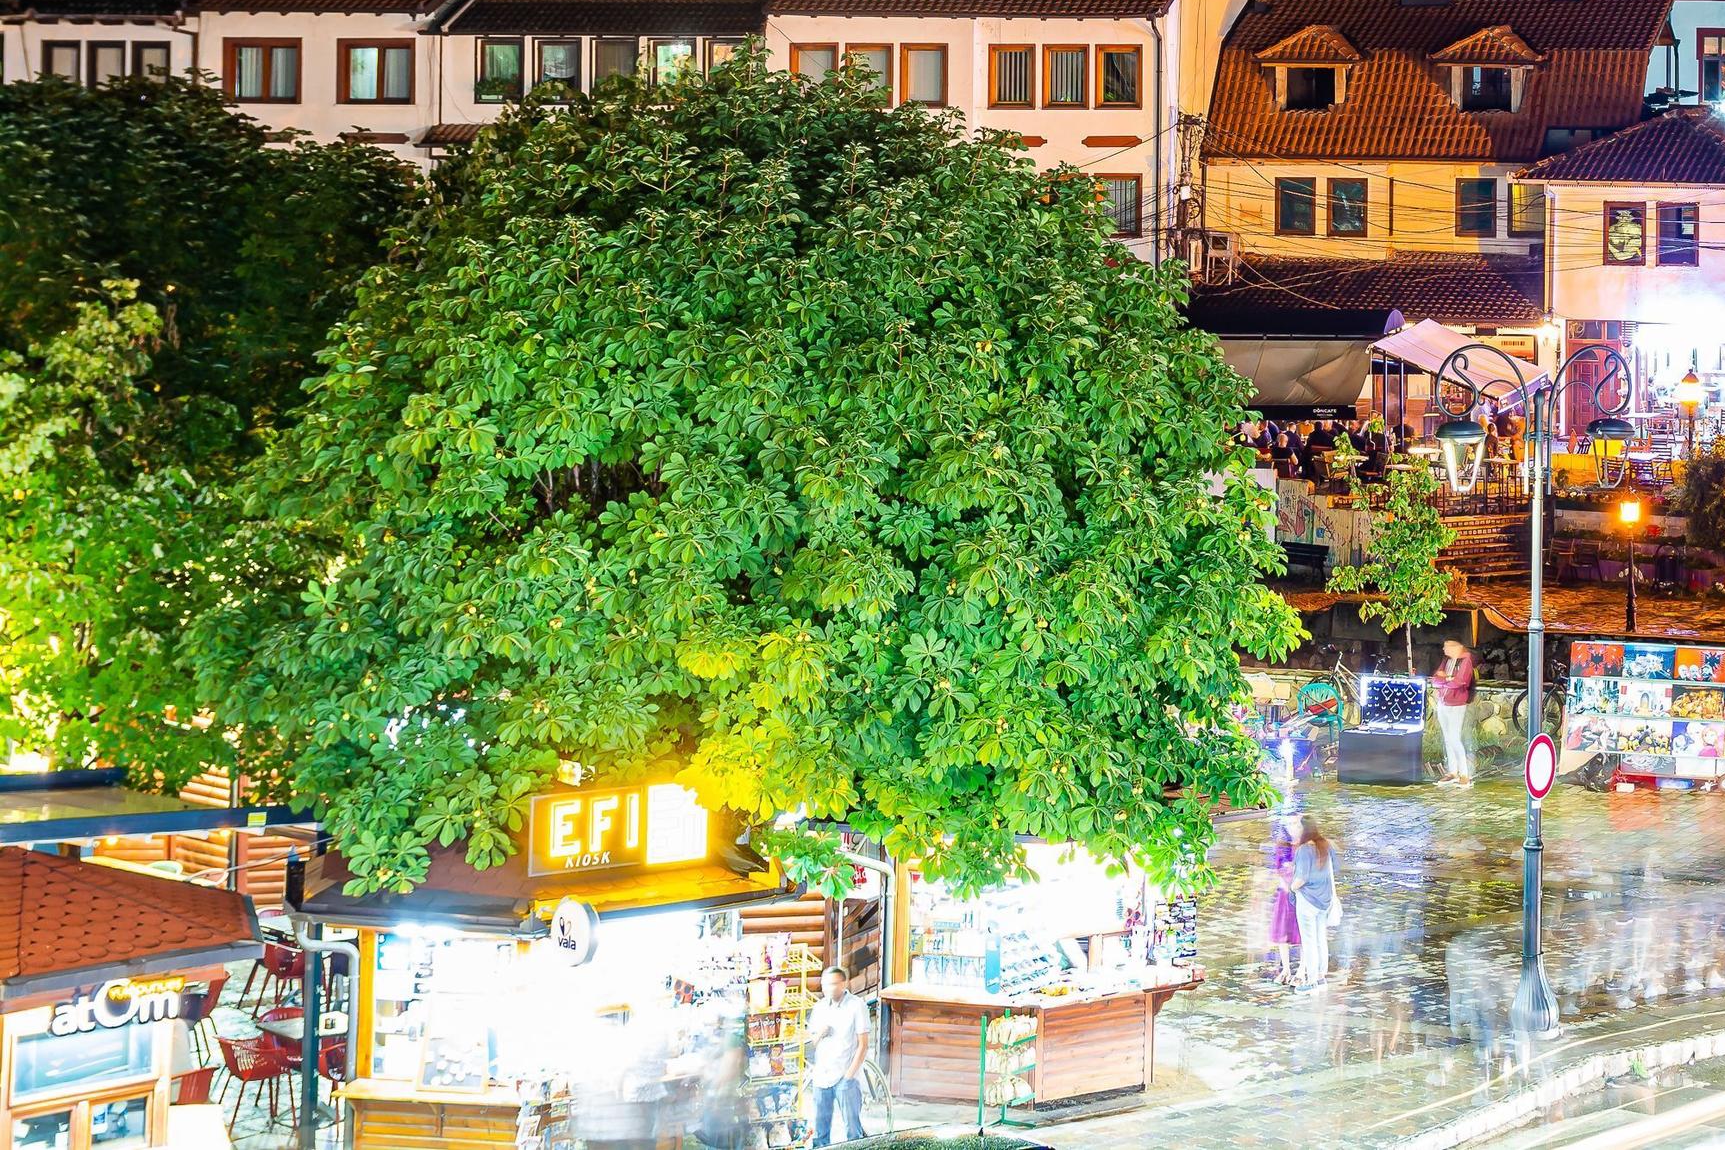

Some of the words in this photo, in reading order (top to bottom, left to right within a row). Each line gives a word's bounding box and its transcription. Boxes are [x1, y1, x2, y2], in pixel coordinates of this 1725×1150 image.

[550, 794, 640, 857] EFI
[565, 851, 611, 868] KIOSK
[558, 935, 577, 950] vala
